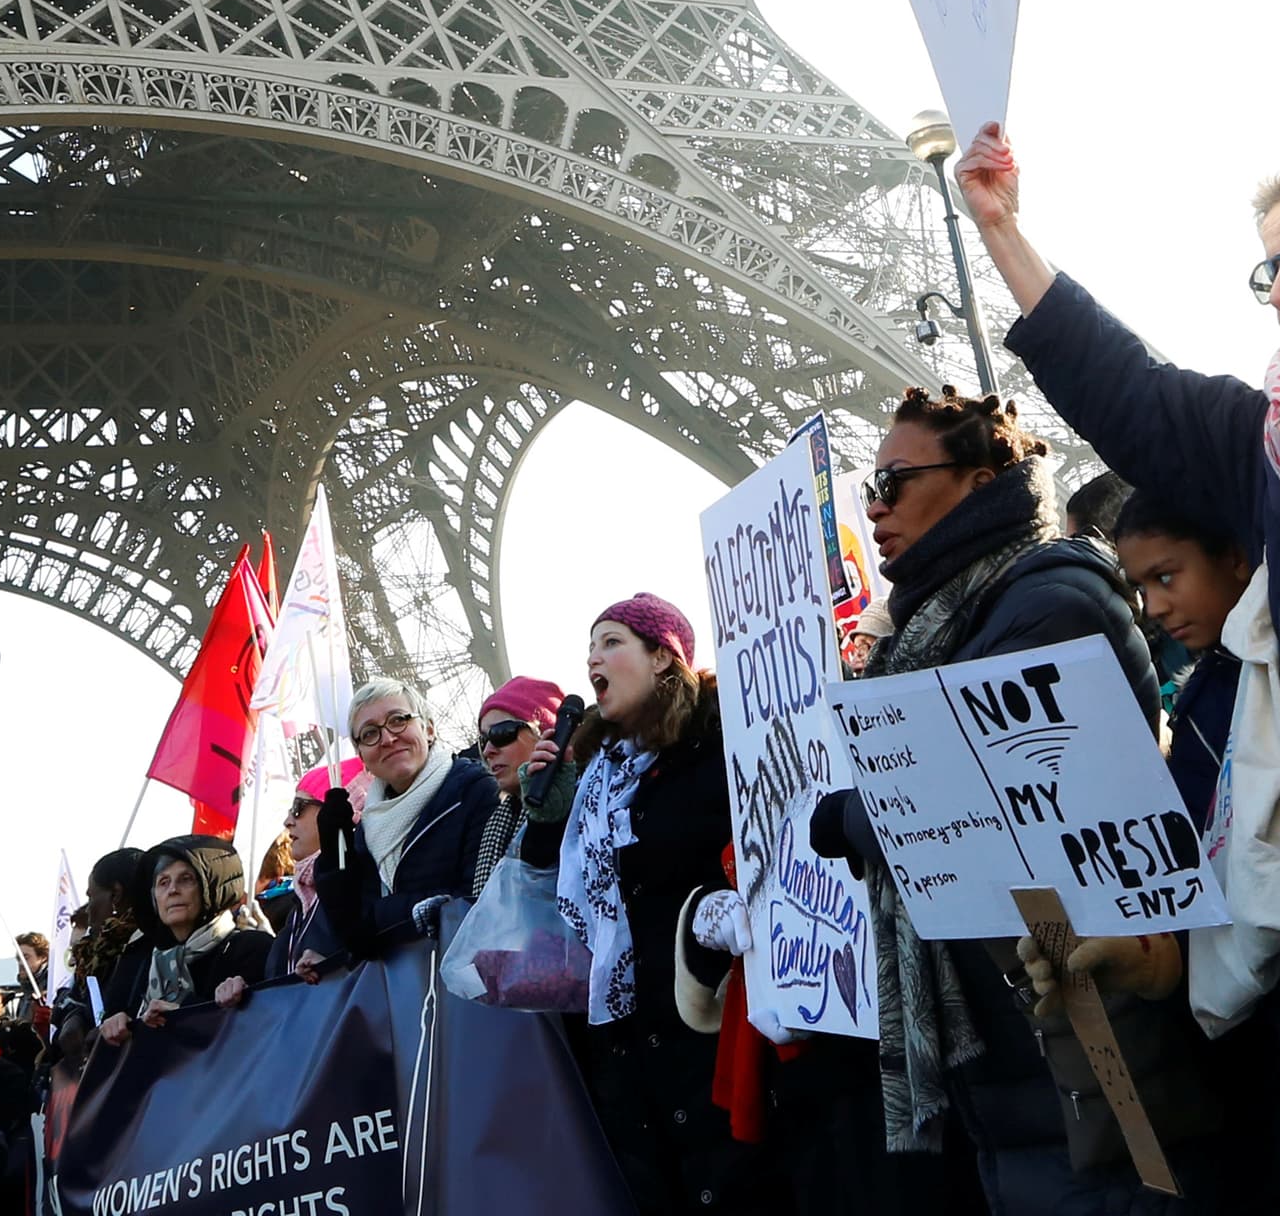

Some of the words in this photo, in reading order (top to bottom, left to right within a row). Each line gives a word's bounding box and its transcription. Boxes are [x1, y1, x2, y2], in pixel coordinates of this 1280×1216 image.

[960, 663, 1066, 736] NOT
[1004, 781, 1066, 826] MY
[1060, 809, 1201, 889] PRESID
[1115, 886, 1177, 919] ENT
[770, 900, 831, 1024] Family
[92, 1158, 203, 1216] WOMEN'S
[209, 1129, 312, 1193] RIGHTS
[323, 1109, 400, 1165] ARE
[231, 1186, 350, 1216] HTS
